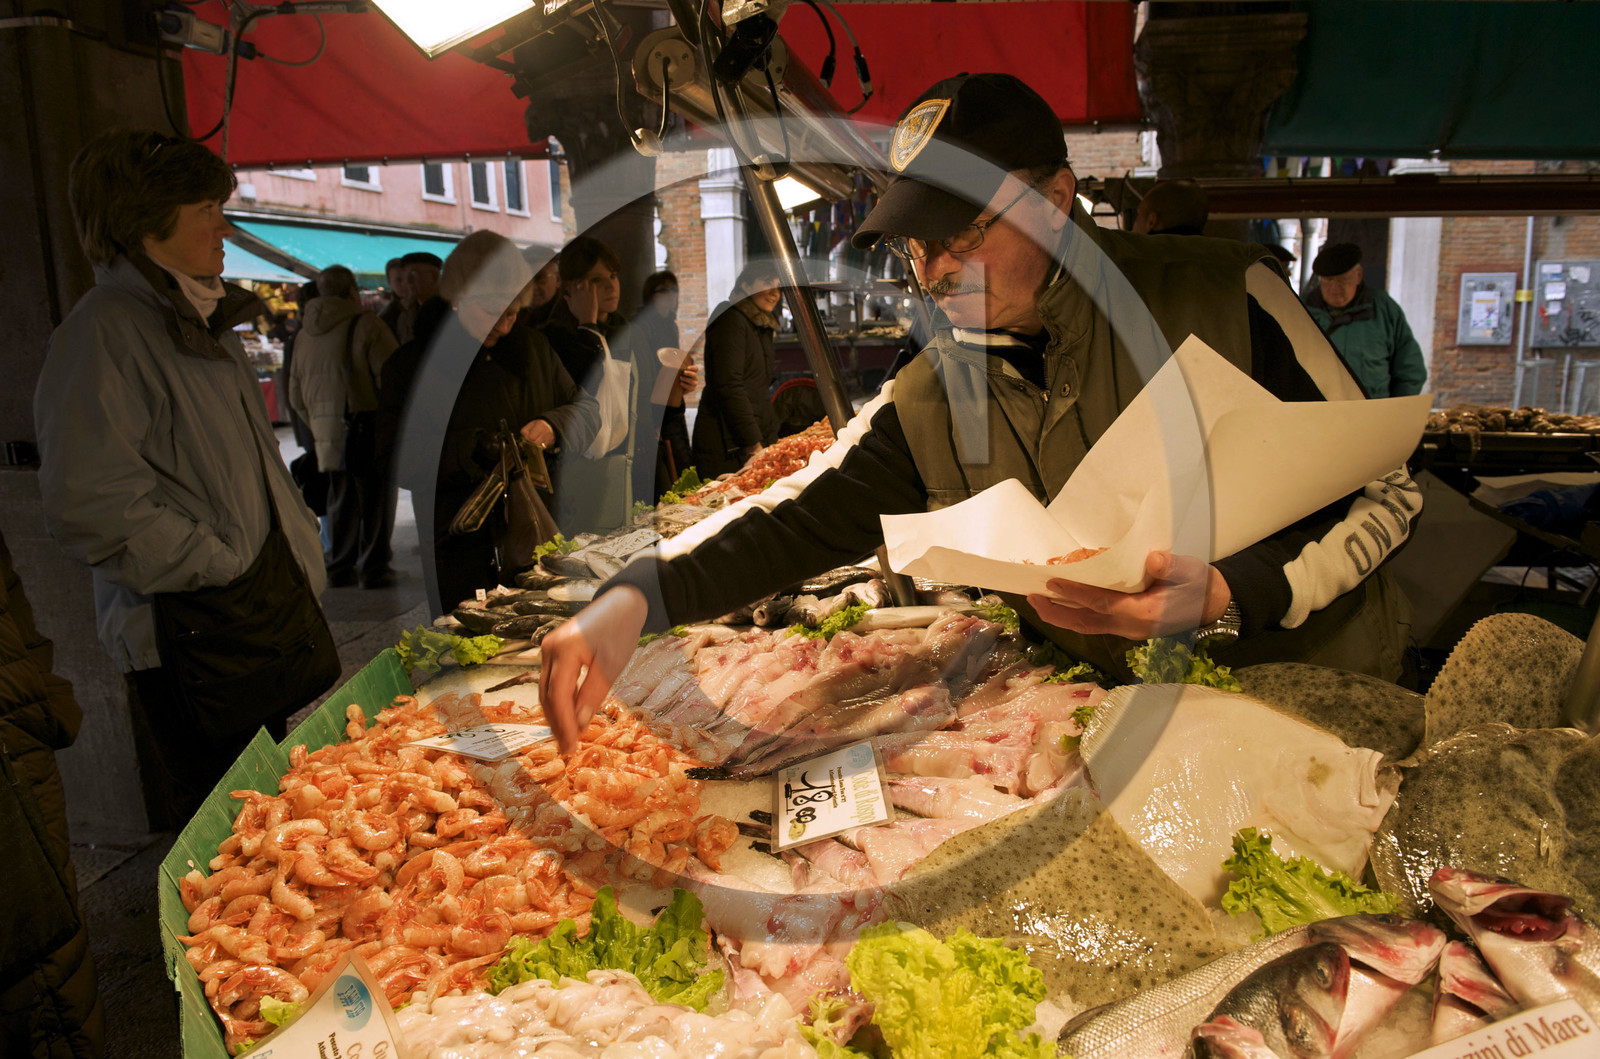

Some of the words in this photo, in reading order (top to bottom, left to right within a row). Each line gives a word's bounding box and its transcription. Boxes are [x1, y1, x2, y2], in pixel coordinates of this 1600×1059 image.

[851, 769, 876, 791] Code
[854, 790, 878, 799] di
[850, 796, 880, 823] Rospo
[1505, 1026, 1533, 1057] di
[1524, 1014, 1590, 1050] Mare
